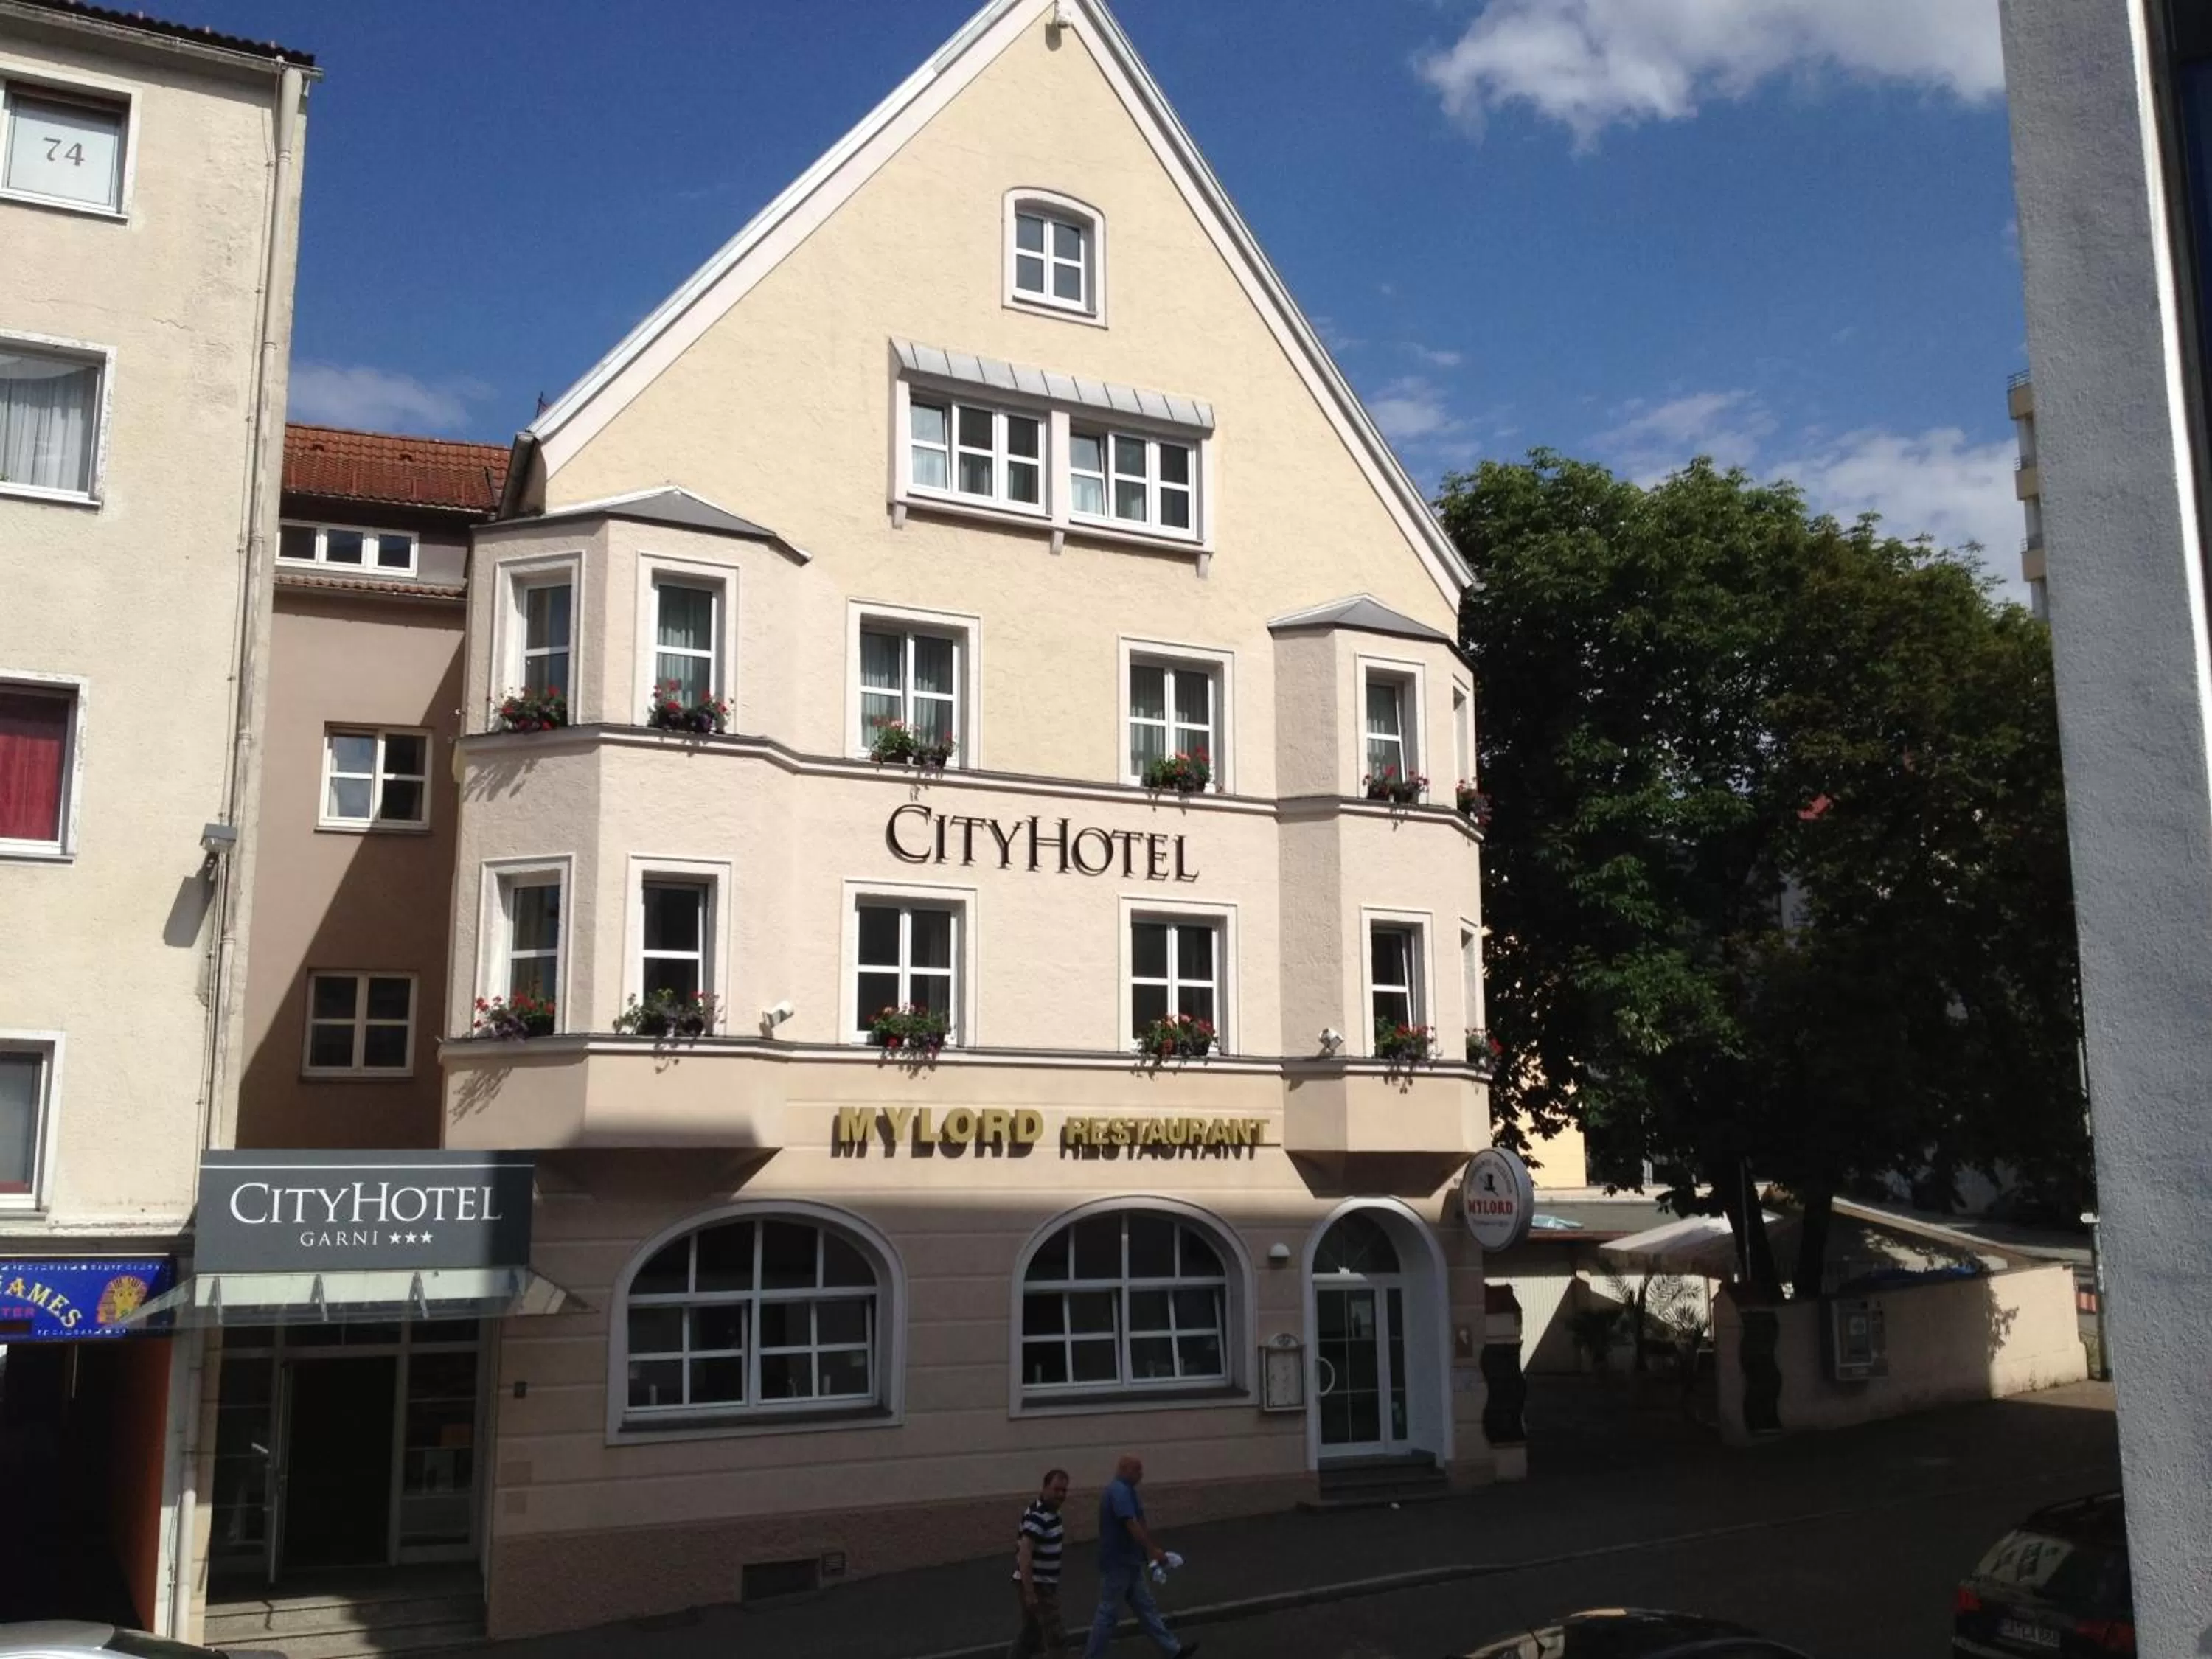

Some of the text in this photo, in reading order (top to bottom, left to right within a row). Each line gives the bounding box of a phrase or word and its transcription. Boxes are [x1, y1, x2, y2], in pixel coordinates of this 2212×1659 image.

[43, 136, 85, 166] 74
[837, 1106, 1270, 1147] MYLORD RESTAURANT
[1468, 1200, 1513, 1215] MYLORD
[300, 1231, 379, 1248] GARNI
[0, 1275, 83, 1328] AMES
